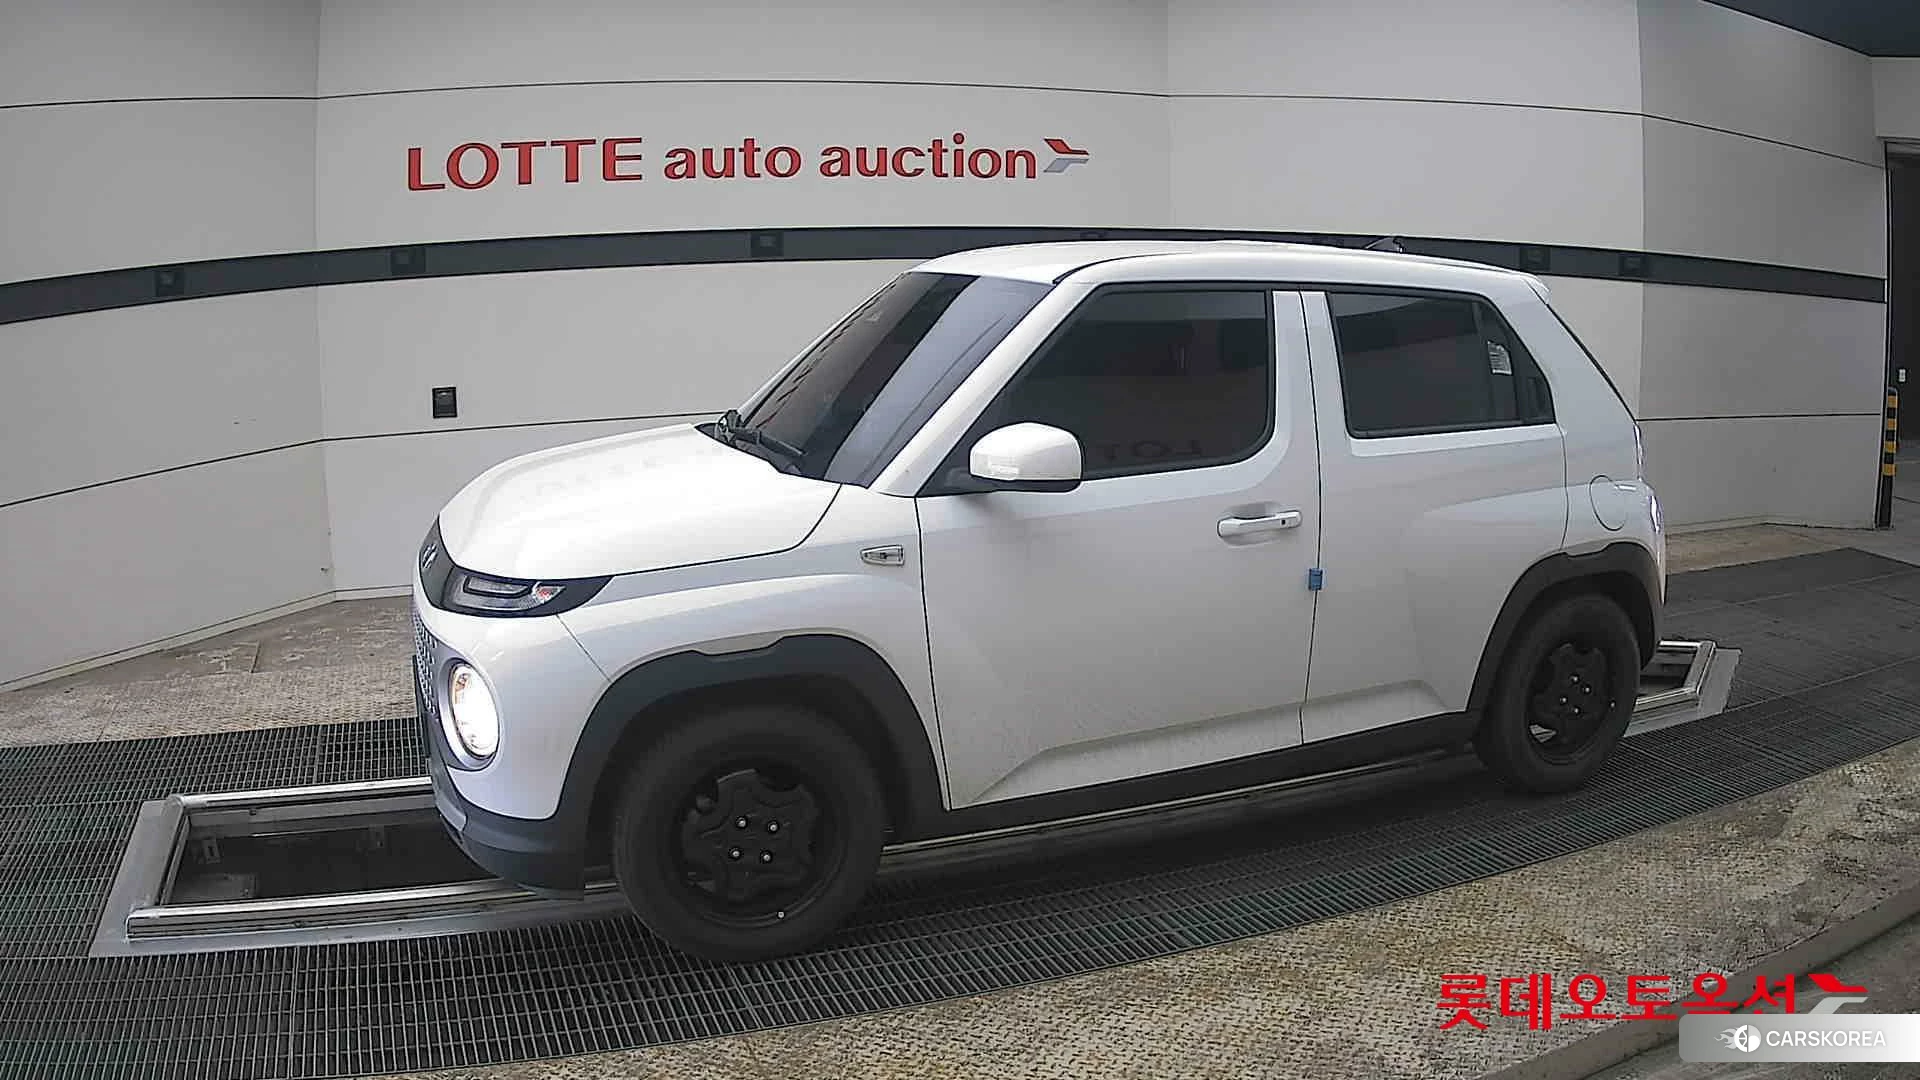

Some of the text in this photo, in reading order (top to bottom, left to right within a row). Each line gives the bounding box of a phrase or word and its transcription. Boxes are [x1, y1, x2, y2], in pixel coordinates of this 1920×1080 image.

[407, 132, 1036, 192] LOTTE auto auction
